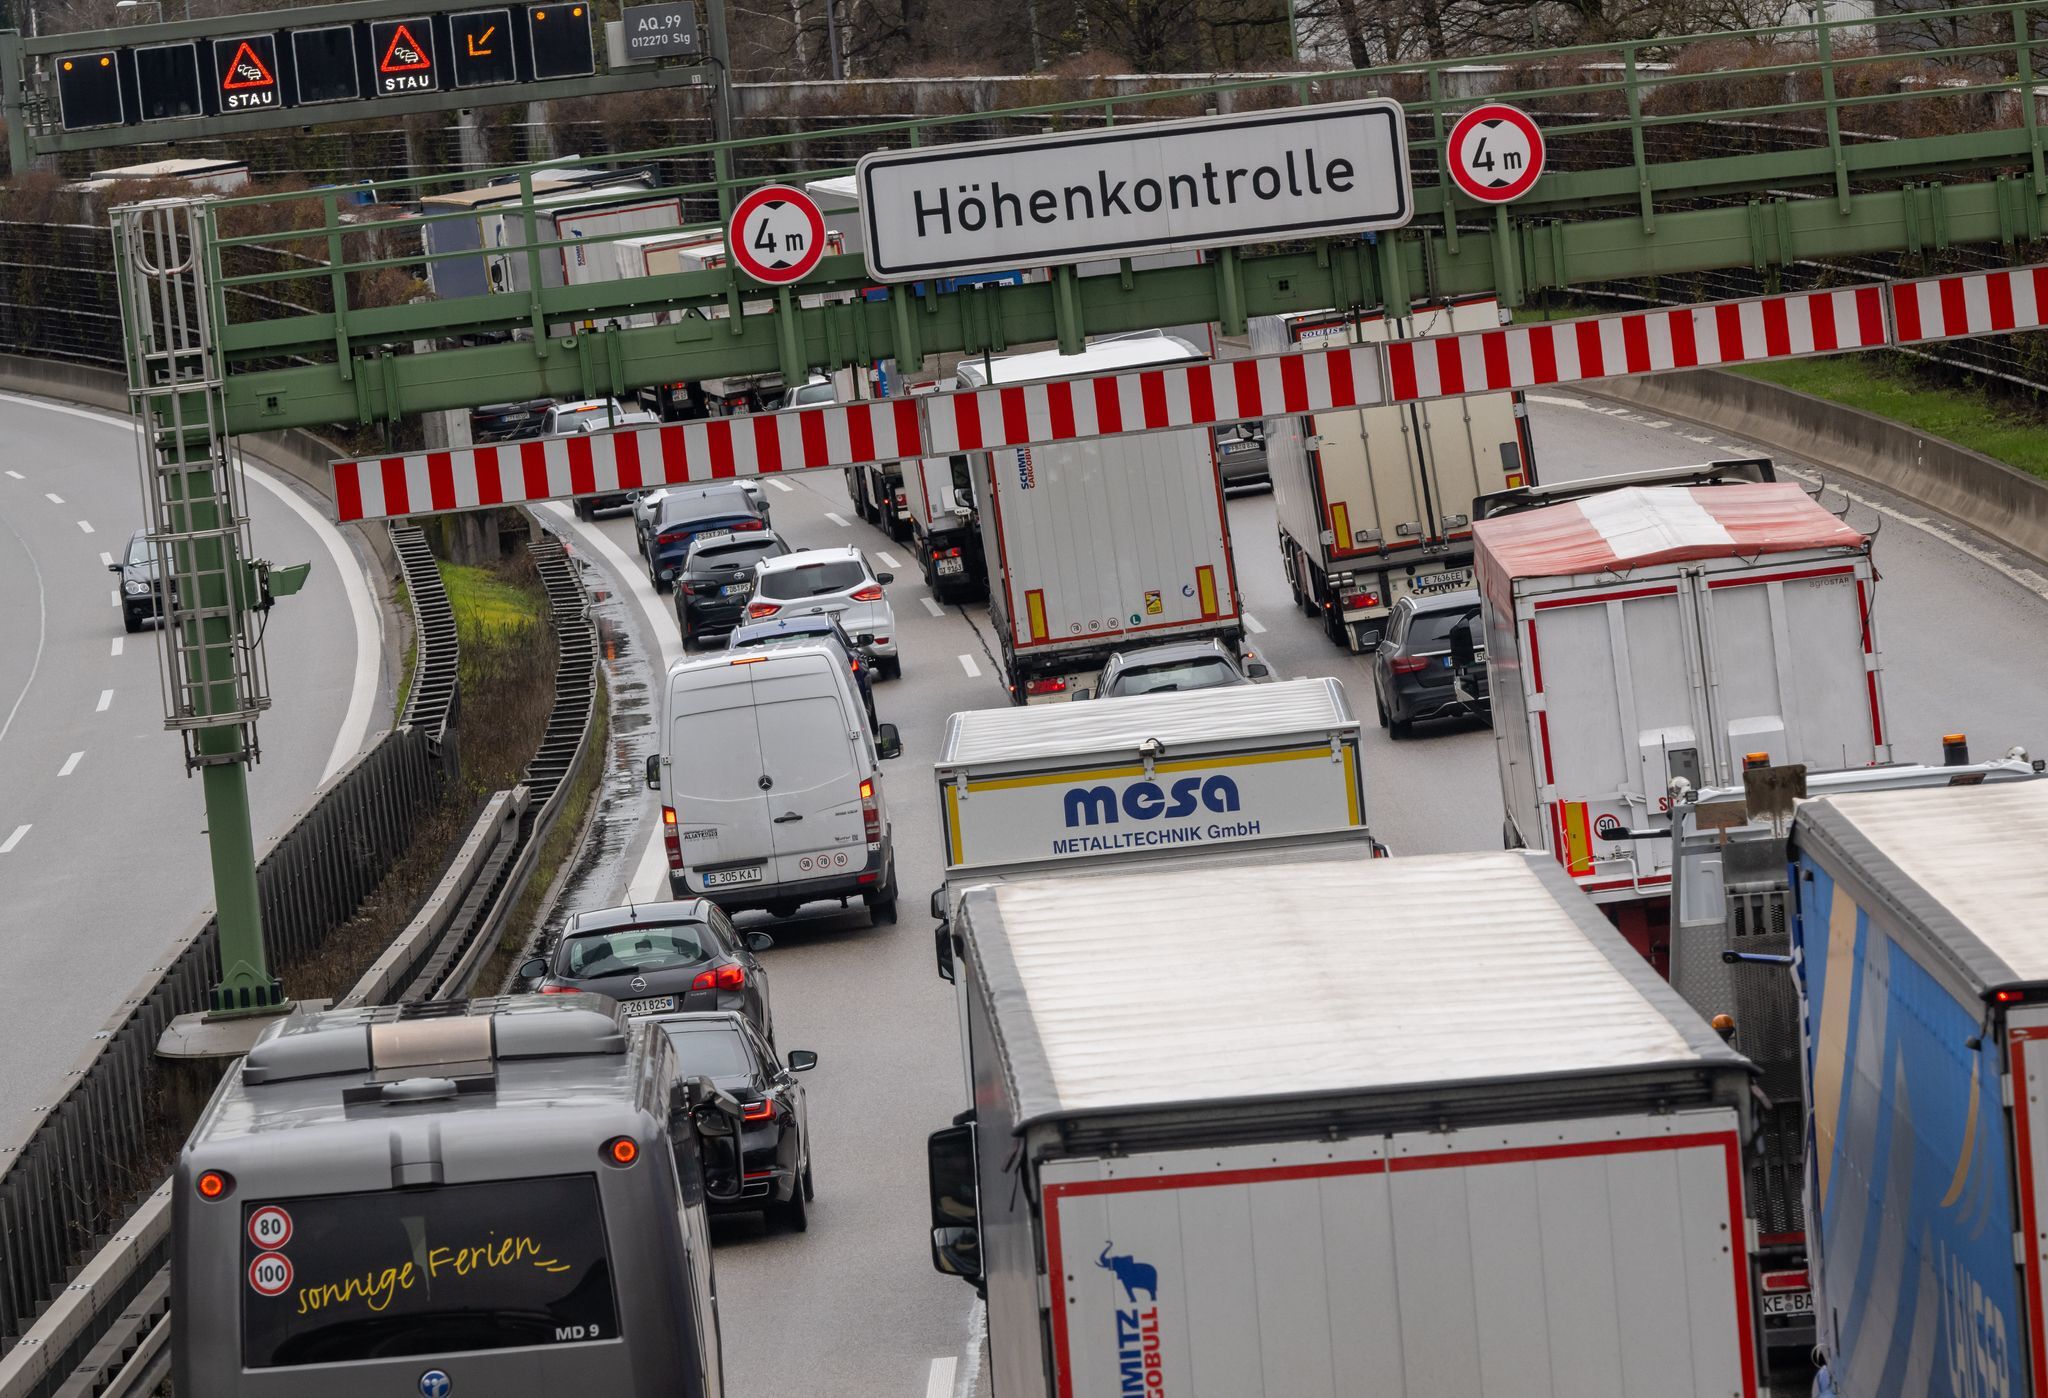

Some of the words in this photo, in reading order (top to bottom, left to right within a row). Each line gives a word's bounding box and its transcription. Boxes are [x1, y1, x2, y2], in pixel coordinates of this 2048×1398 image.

[631, 34, 668, 47] 012270
[673, 33, 690, 45] Stg
[385, 75, 429, 91] STAU
[228, 91, 272, 108] STAU
[1472, 137, 1495, 172] 4
[1503, 152, 1522, 170] m
[913, 148, 1354, 237] Höhenkontrolle
[754, 218, 777, 253] 4
[785, 233, 804, 251] m
[1016, 448, 1029, 490] SCHMIT
[1024, 447, 1035, 489] CARGOBU
[1424, 577, 1431, 585] E
[1433, 574, 1451, 584] 7636
[1451, 572, 1461, 581] EE
[1063, 775, 1241, 828] mesa
[1053, 826, 1202, 854] METALLTECHNIK
[1207, 820, 1261, 839] GmbH
[837, 855, 845, 863] 90
[709, 874, 717, 883] B
[720, 872, 738, 883] 305
[739, 868, 759, 880] KAT
[260, 1218, 282, 1236] 80
[257, 1265, 285, 1283] 100
[297, 1261, 415, 1314] sonnige
[428, 1231, 541, 1278] Ferien
[1763, 1296, 1784, 1313] KE
[1794, 1294, 1814, 1310] BA
[555, 1326, 585, 1341] MD
[589, 1324, 599, 1337] 9
[1116, 1308, 1145, 1398] MITZ
